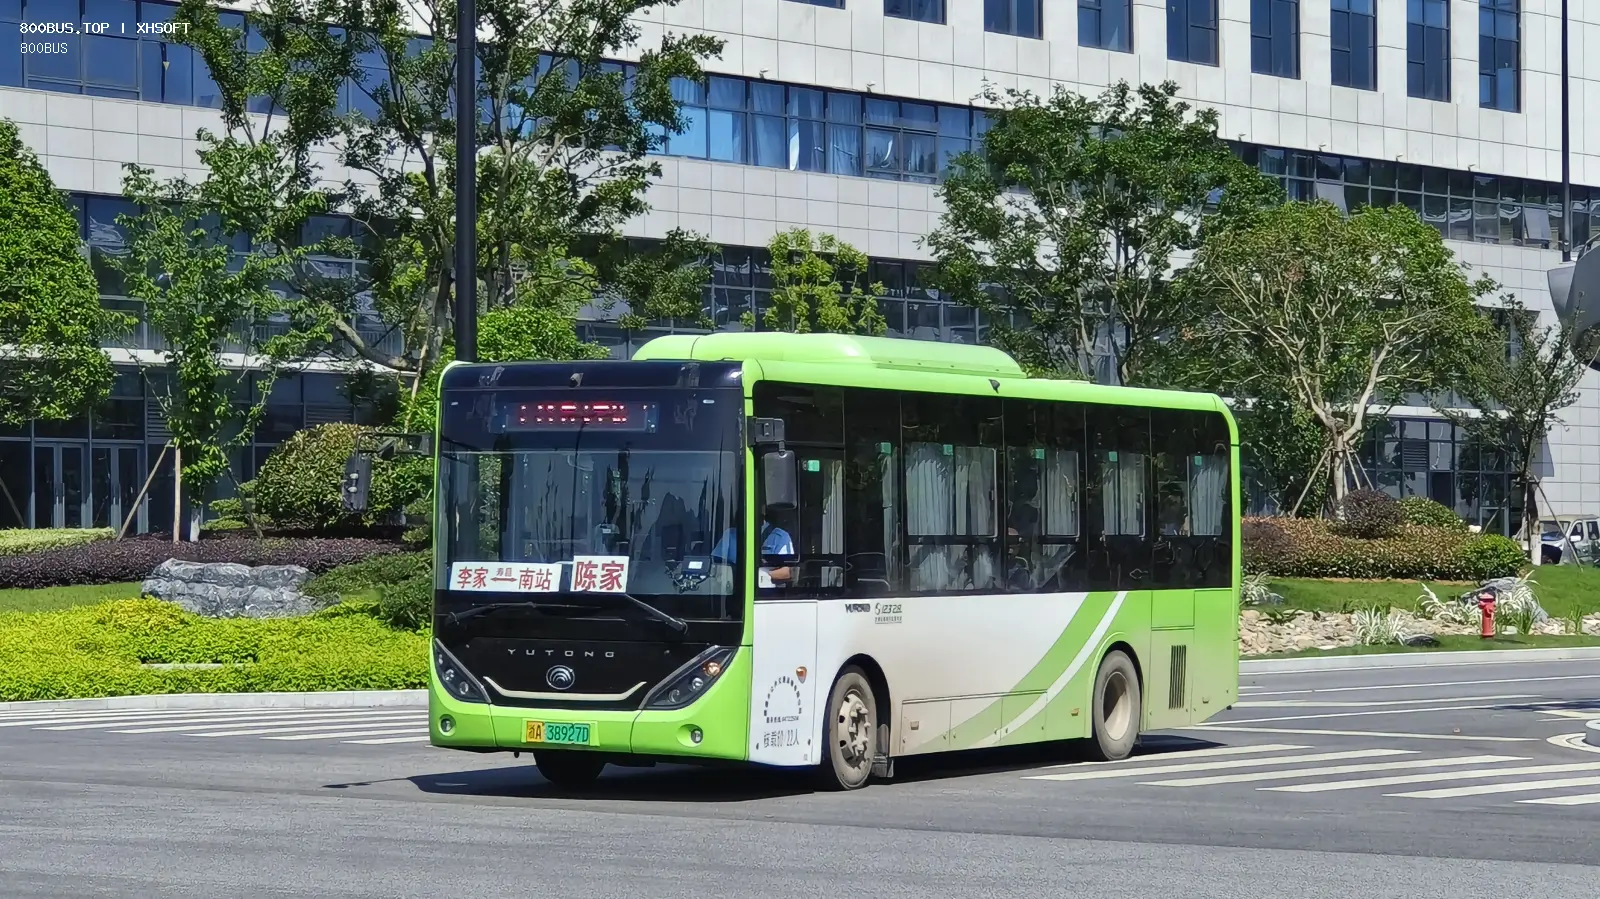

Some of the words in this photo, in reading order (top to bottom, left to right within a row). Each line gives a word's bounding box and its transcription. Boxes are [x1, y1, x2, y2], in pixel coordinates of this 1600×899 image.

[457, 566, 489, 589] 李家
[518, 567, 553, 591] 南站
[573, 560, 625, 591] 陈家
[507, 648, 615, 658] YUTONG
[546, 724, 589, 742] 38927D
